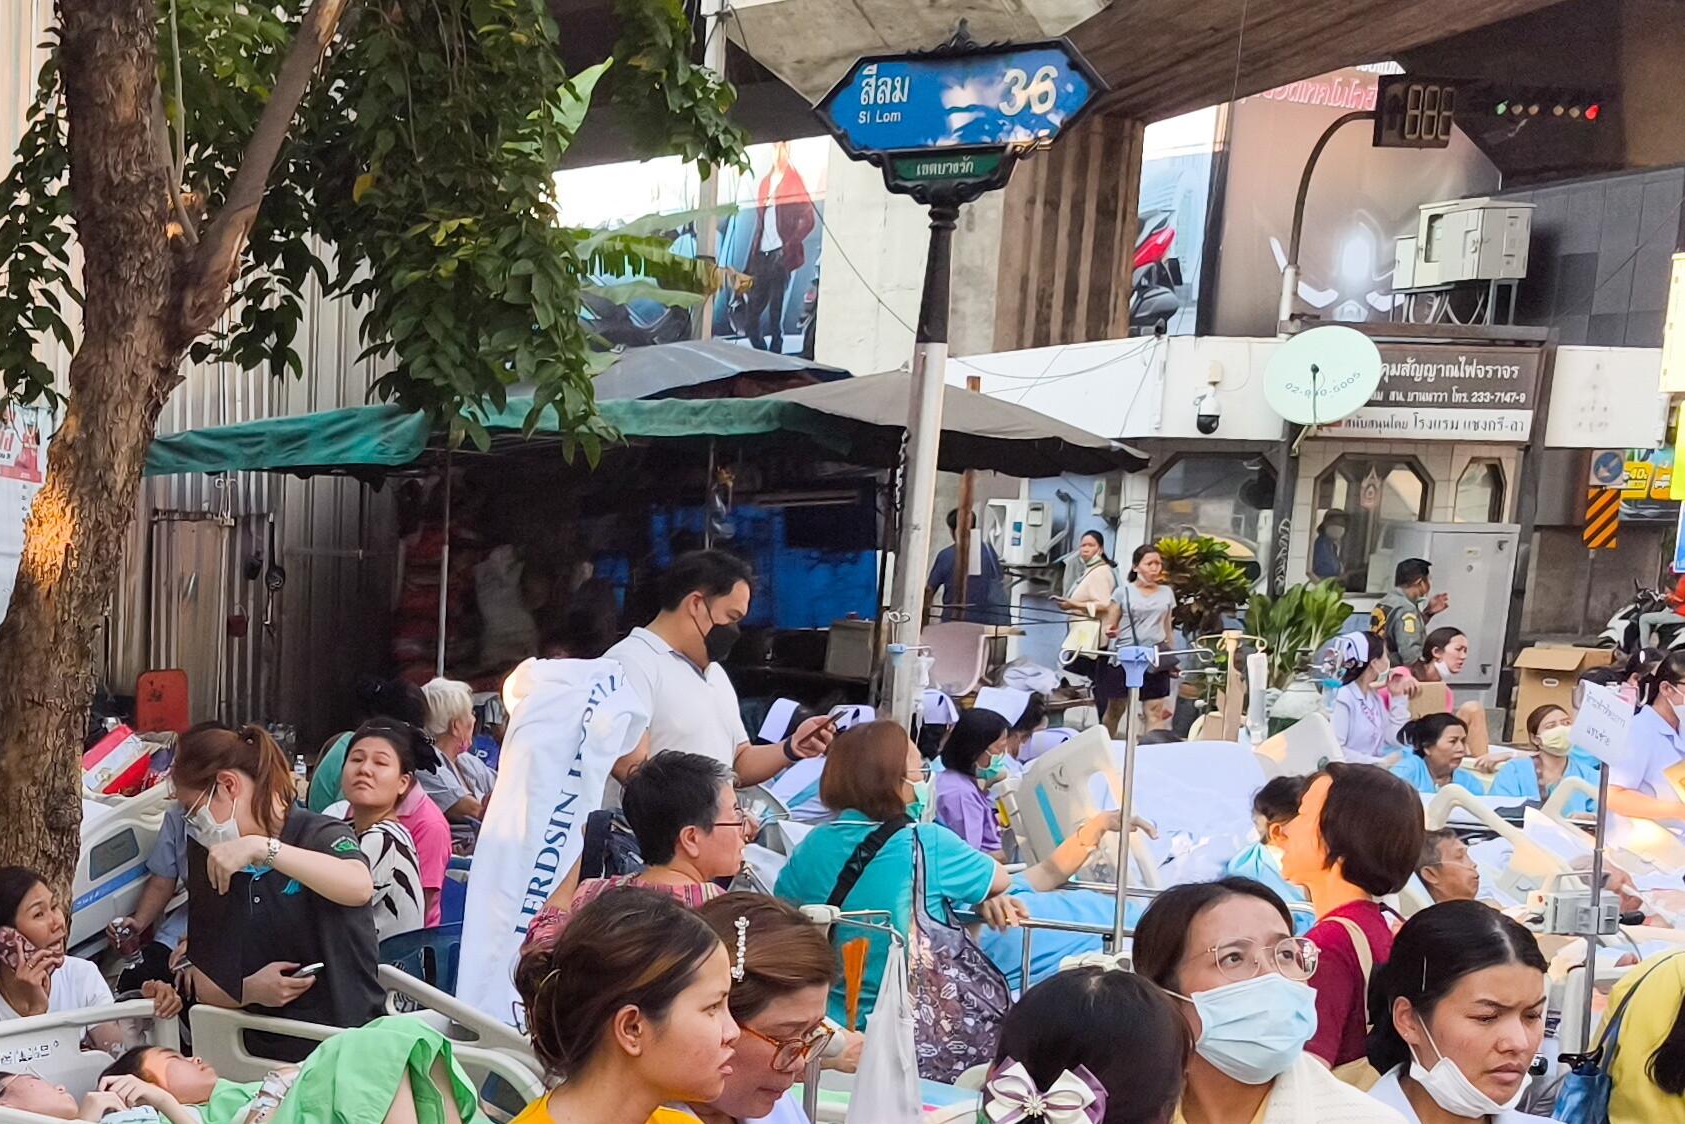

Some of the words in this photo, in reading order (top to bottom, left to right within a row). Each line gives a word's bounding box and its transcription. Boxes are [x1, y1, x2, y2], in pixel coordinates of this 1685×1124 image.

[860, 64, 909, 105] สีลม
[998, 65, 1058, 118] 36
[858, 111, 870, 124] Si
[876, 110, 901, 123] Lom
[916, 155, 974, 176] เขตบางรัก
